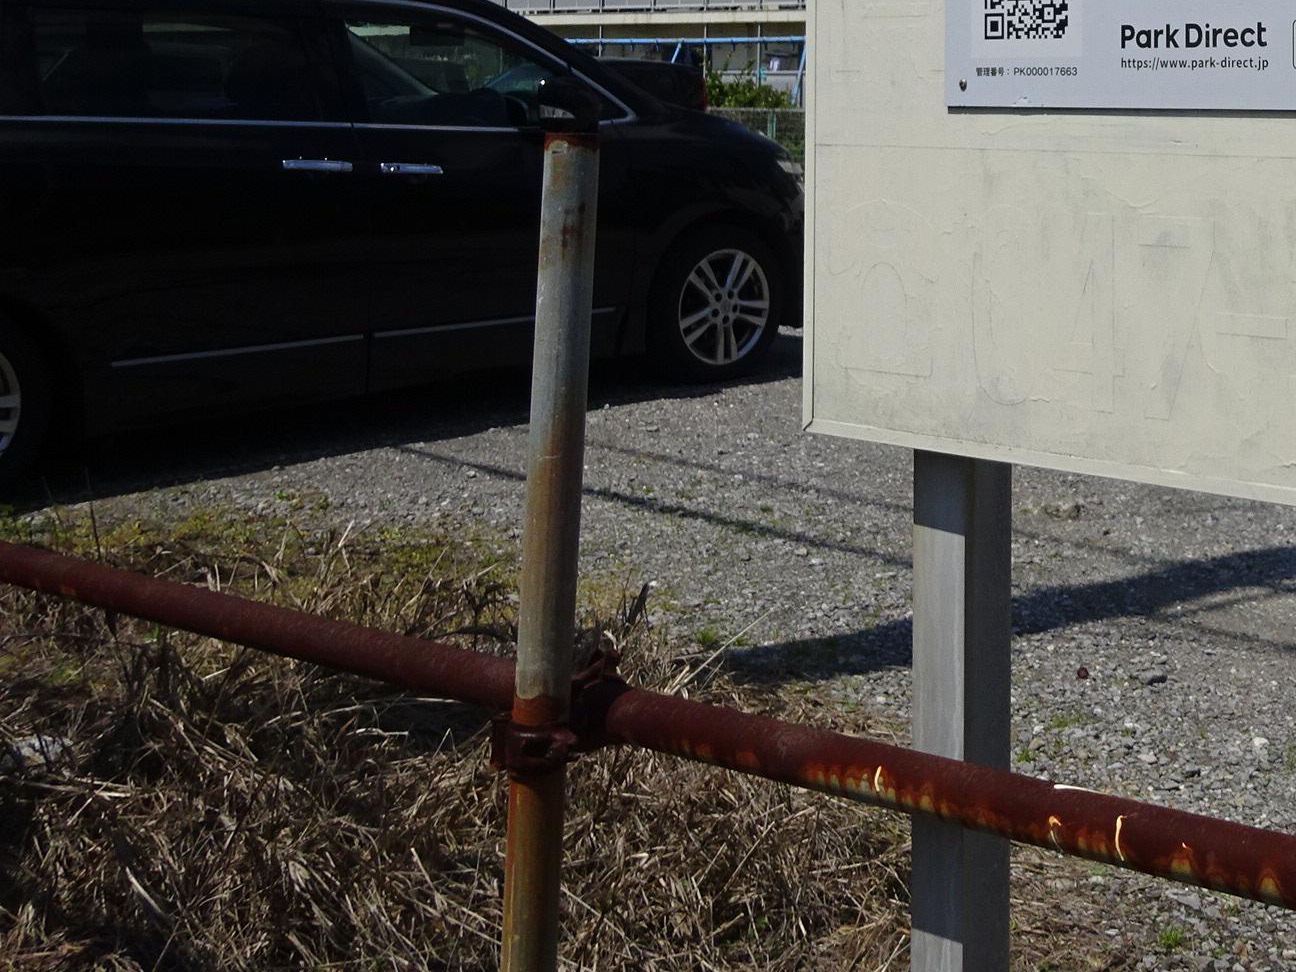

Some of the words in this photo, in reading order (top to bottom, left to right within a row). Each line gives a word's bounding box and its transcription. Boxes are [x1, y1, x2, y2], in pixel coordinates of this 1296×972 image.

[1120, 23, 1180, 49] Park
[1185, 21, 1268, 49] Direct
[1120, 56, 1269, 72] https://www.park-direct.jp
